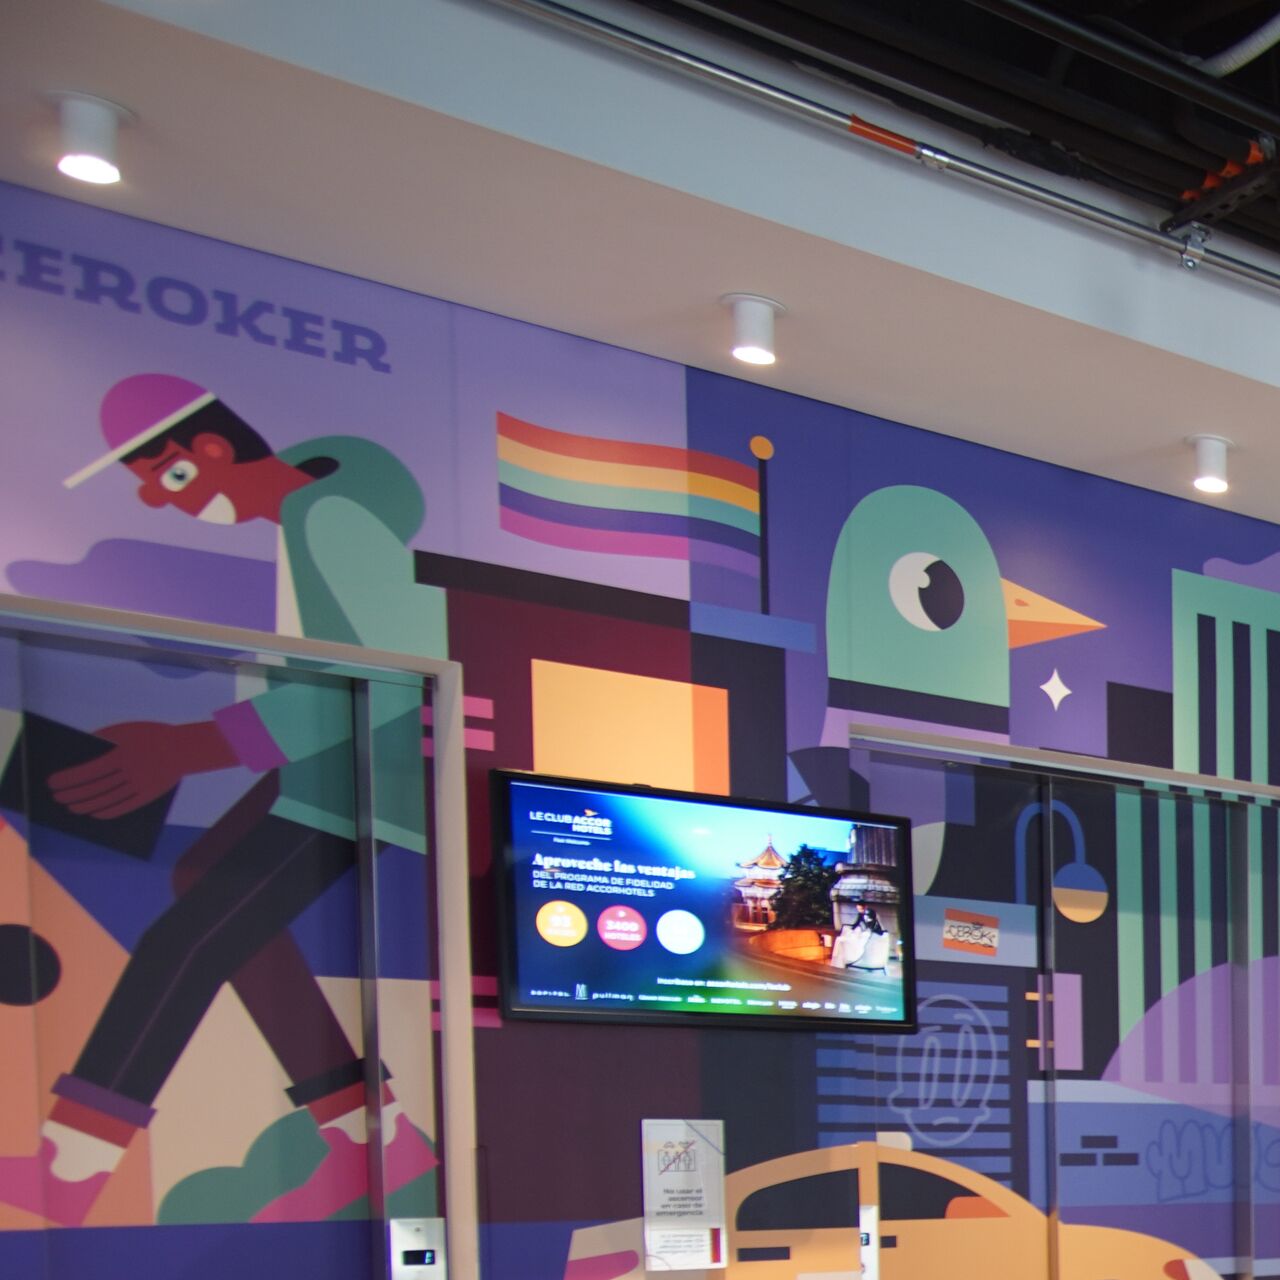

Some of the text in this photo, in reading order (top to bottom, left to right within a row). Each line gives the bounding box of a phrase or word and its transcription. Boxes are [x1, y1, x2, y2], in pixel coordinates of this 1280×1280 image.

[0, 235, 393, 374] EROKER
[545, 812, 573, 824] CLUB
[573, 815, 613, 828] ACCOR
[572, 824, 613, 836] HOTELS
[532, 853, 697, 881] Aproveche las ventajas
[533, 880, 656, 898] DE LA RED ACCORHOTELS
[555, 872, 610, 885] PROGRAMA
[610, 876, 625, 886] DE
[626, 877, 675, 890] FIDELIDAD
